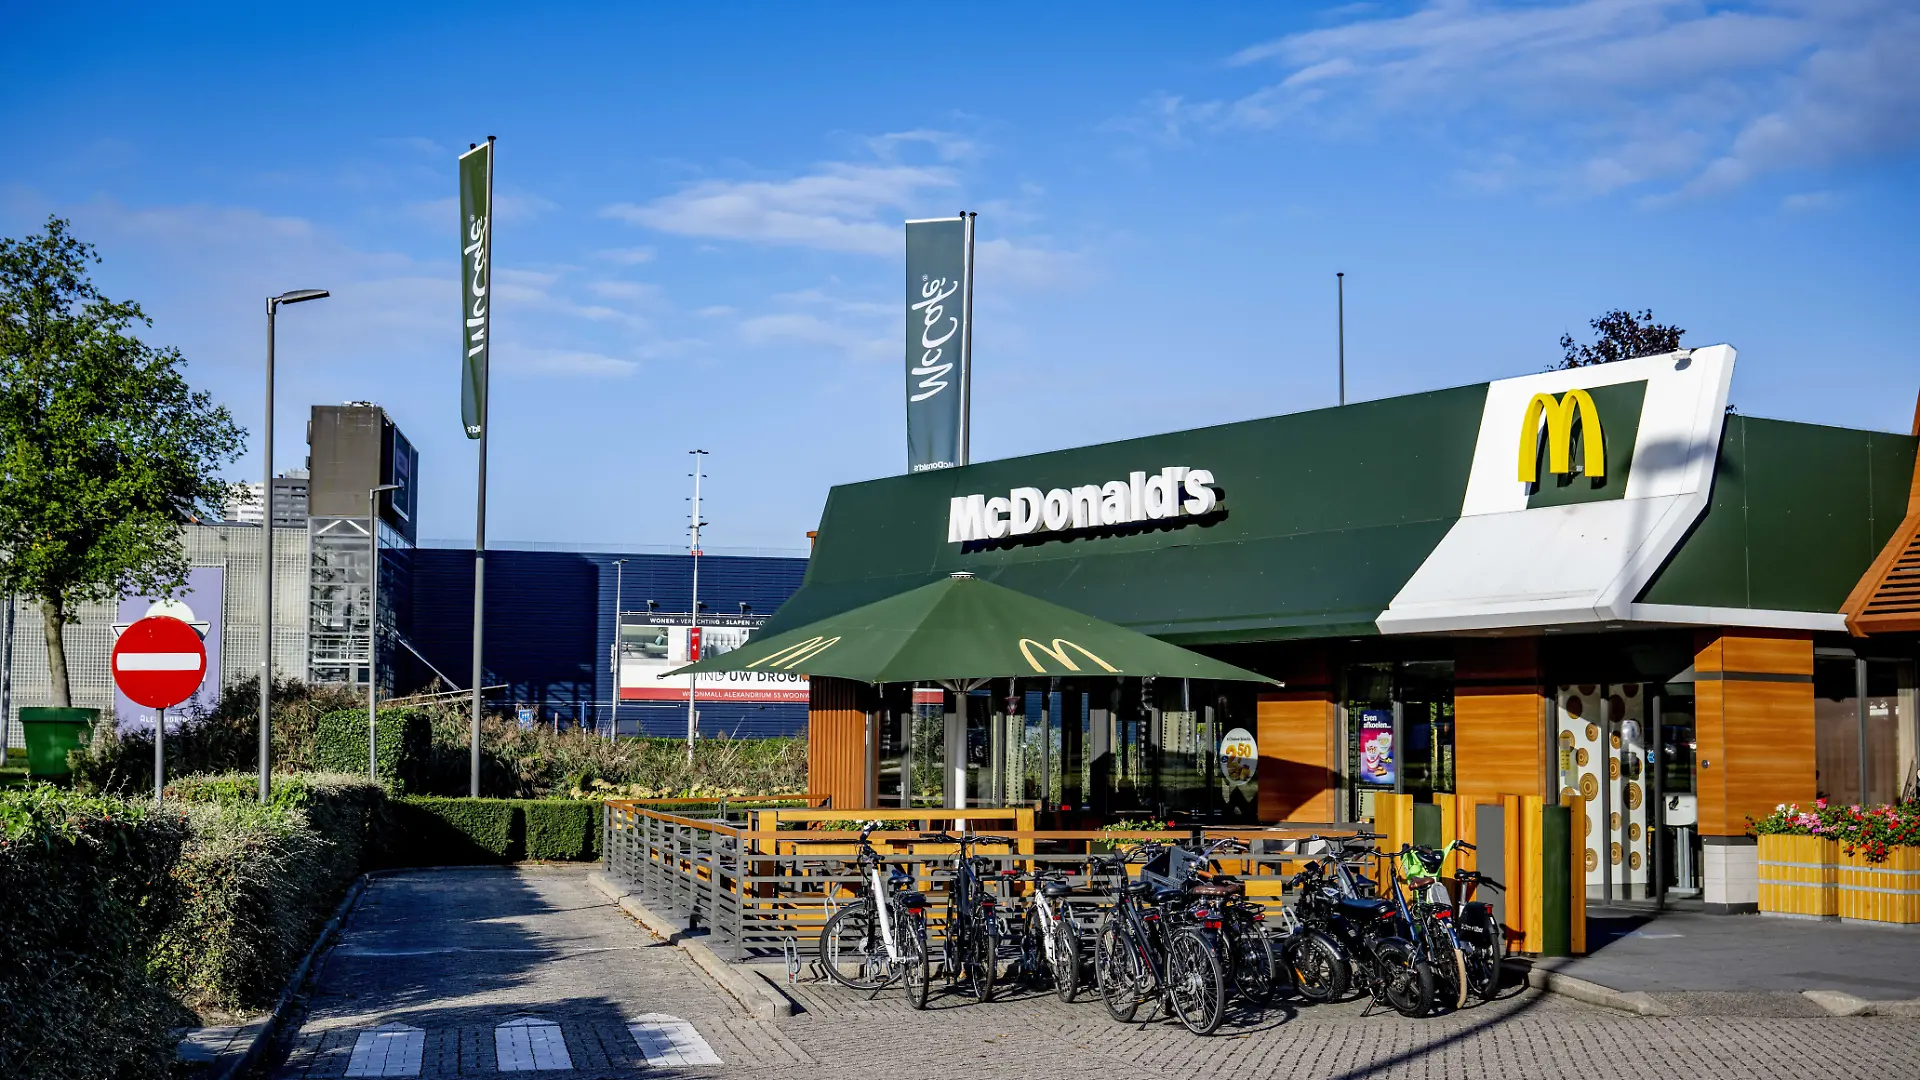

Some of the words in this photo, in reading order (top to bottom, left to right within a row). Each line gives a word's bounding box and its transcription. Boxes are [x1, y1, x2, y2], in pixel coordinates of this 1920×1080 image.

[948, 466, 1216, 543] McDonald's
[729, 671, 751, 682] UW
[724, 691, 772, 699] ALEXANDRIUM
[1363, 714, 1377, 722] Even
